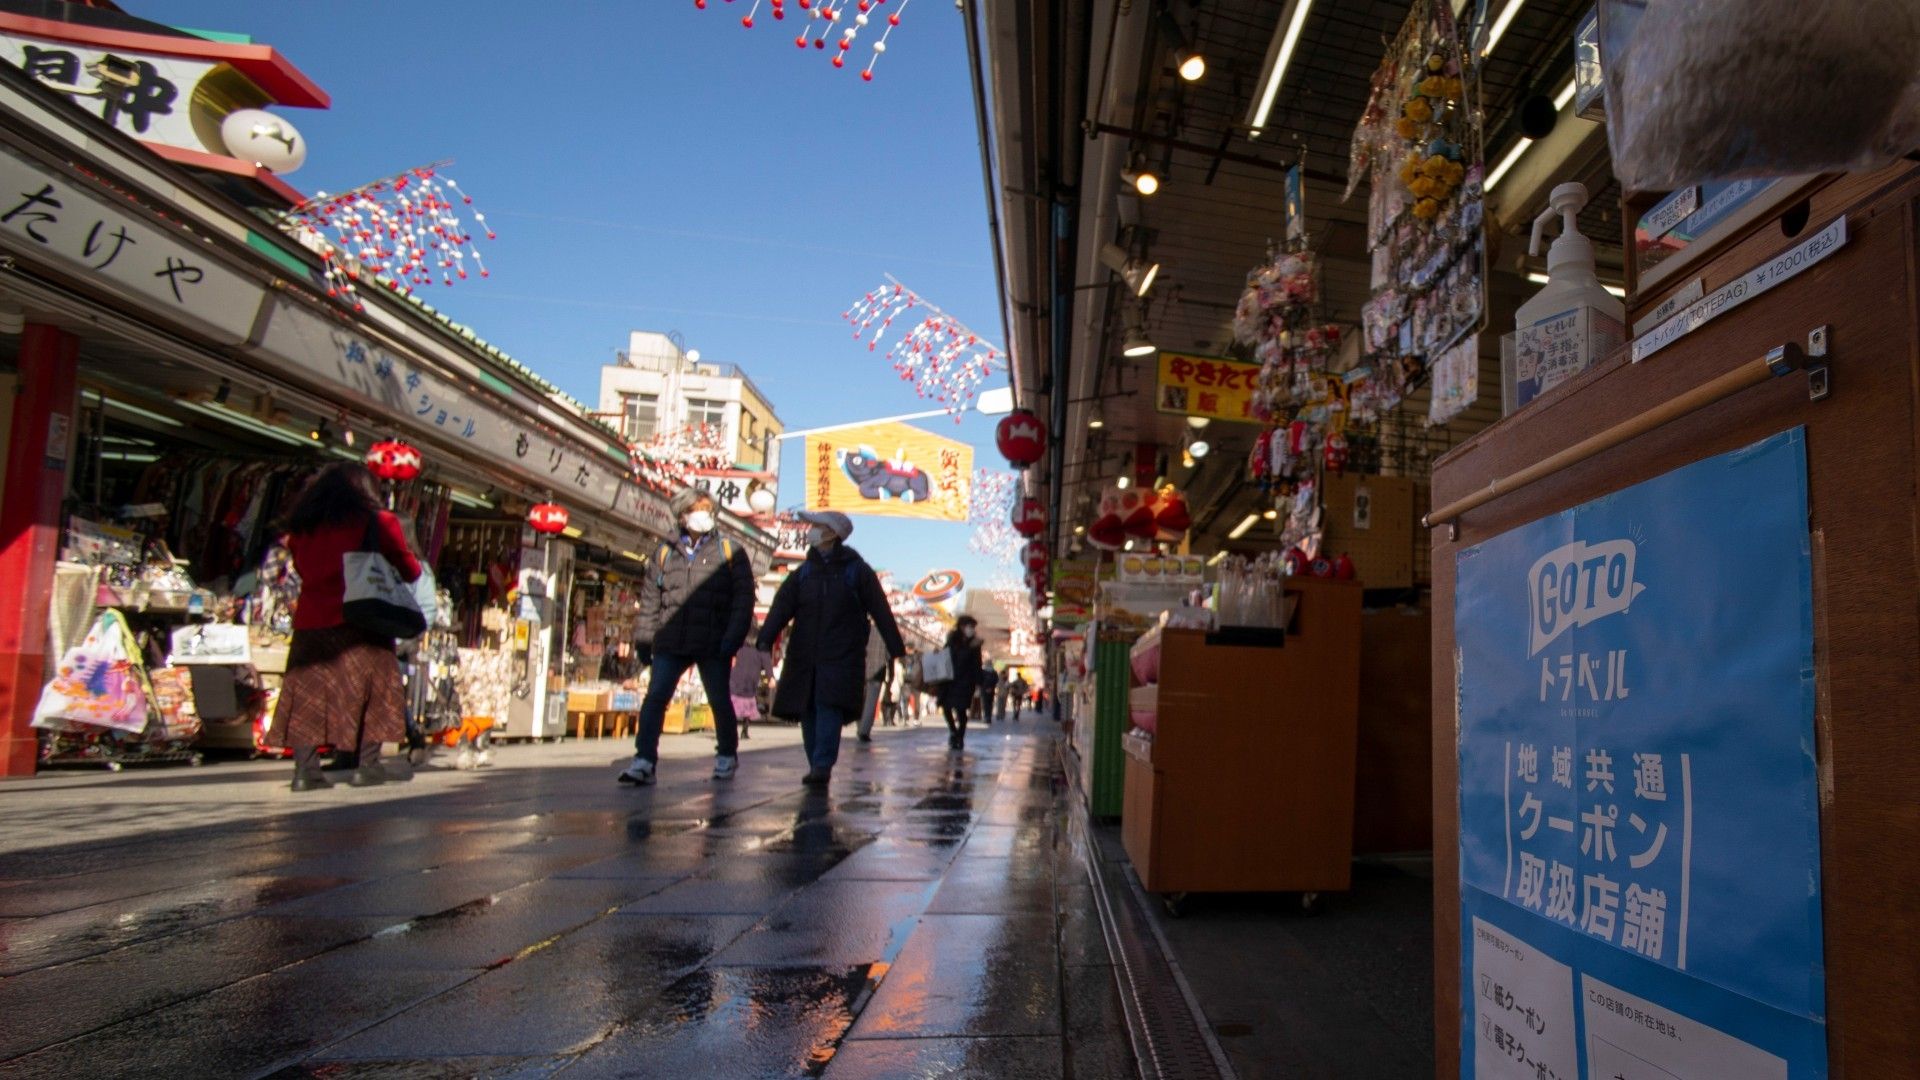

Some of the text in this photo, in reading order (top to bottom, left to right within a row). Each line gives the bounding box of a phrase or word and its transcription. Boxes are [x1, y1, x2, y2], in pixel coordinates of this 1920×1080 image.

[2, 184, 204, 303] たけや
[515, 432, 591, 487] もりた
[1540, 649, 1629, 702] トラベル
[1517, 743, 1666, 801] 地域共通
[1518, 791, 1667, 869] クーポン
[1517, 851, 1666, 960] 取扱店舗
[1494, 982, 1545, 1035] 紙クーポン
[1588, 989, 1684, 1042] この店舗の所在地は、
